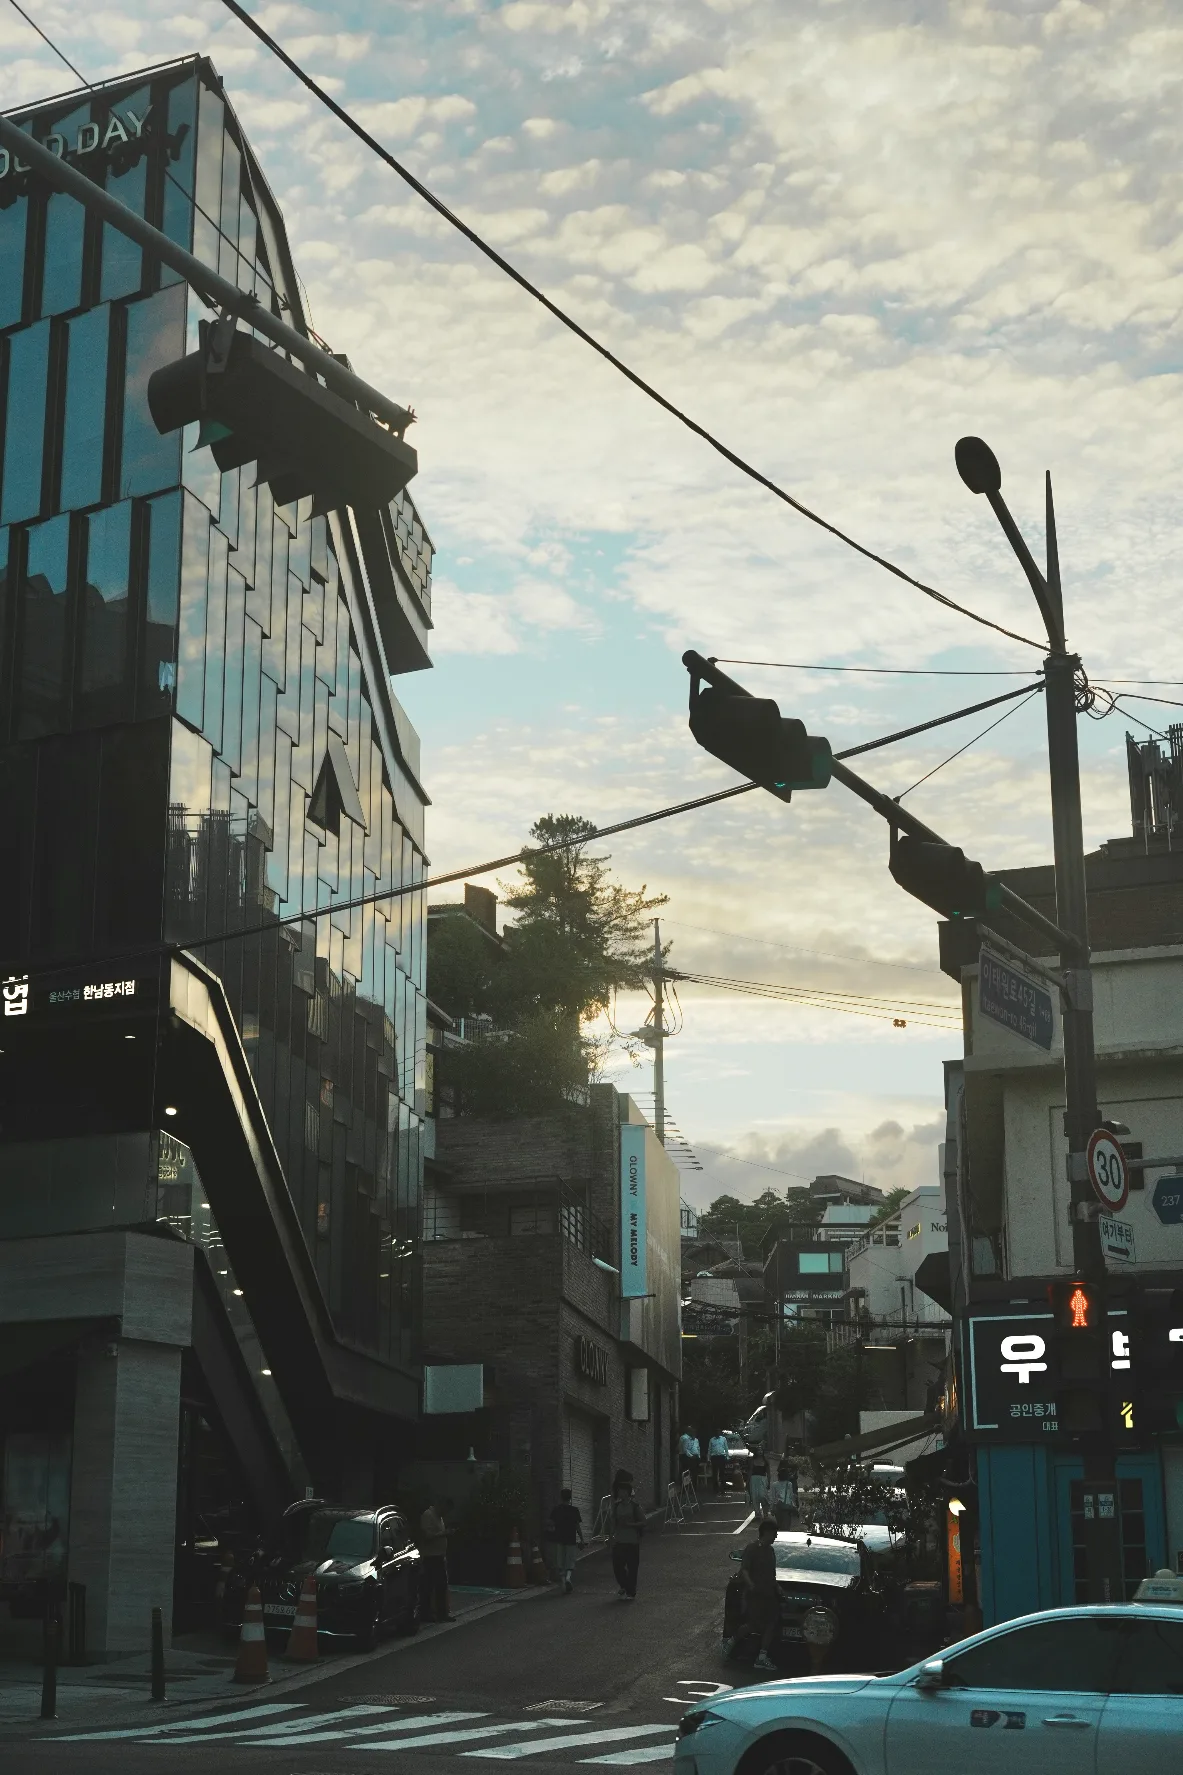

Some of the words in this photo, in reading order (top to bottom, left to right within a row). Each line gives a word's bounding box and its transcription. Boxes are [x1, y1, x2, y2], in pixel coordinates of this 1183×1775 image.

[77, 105, 153, 155] DAY
[83, 979, 136, 1001] 한남동지점
[983, 961, 1036, 1017] 이태원로45길
[629, 1155, 638, 1197] GLOWNY
[1096, 1150, 1122, 1189] 30
[1161, 1194, 1180, 1207] 237
[630, 1213, 638, 1227] MY
[1102, 1221, 1132, 1245] 여기부터
[630, 1230, 638, 1267] MELODY
[1009, 1402, 1057, 1417] 공인중개
